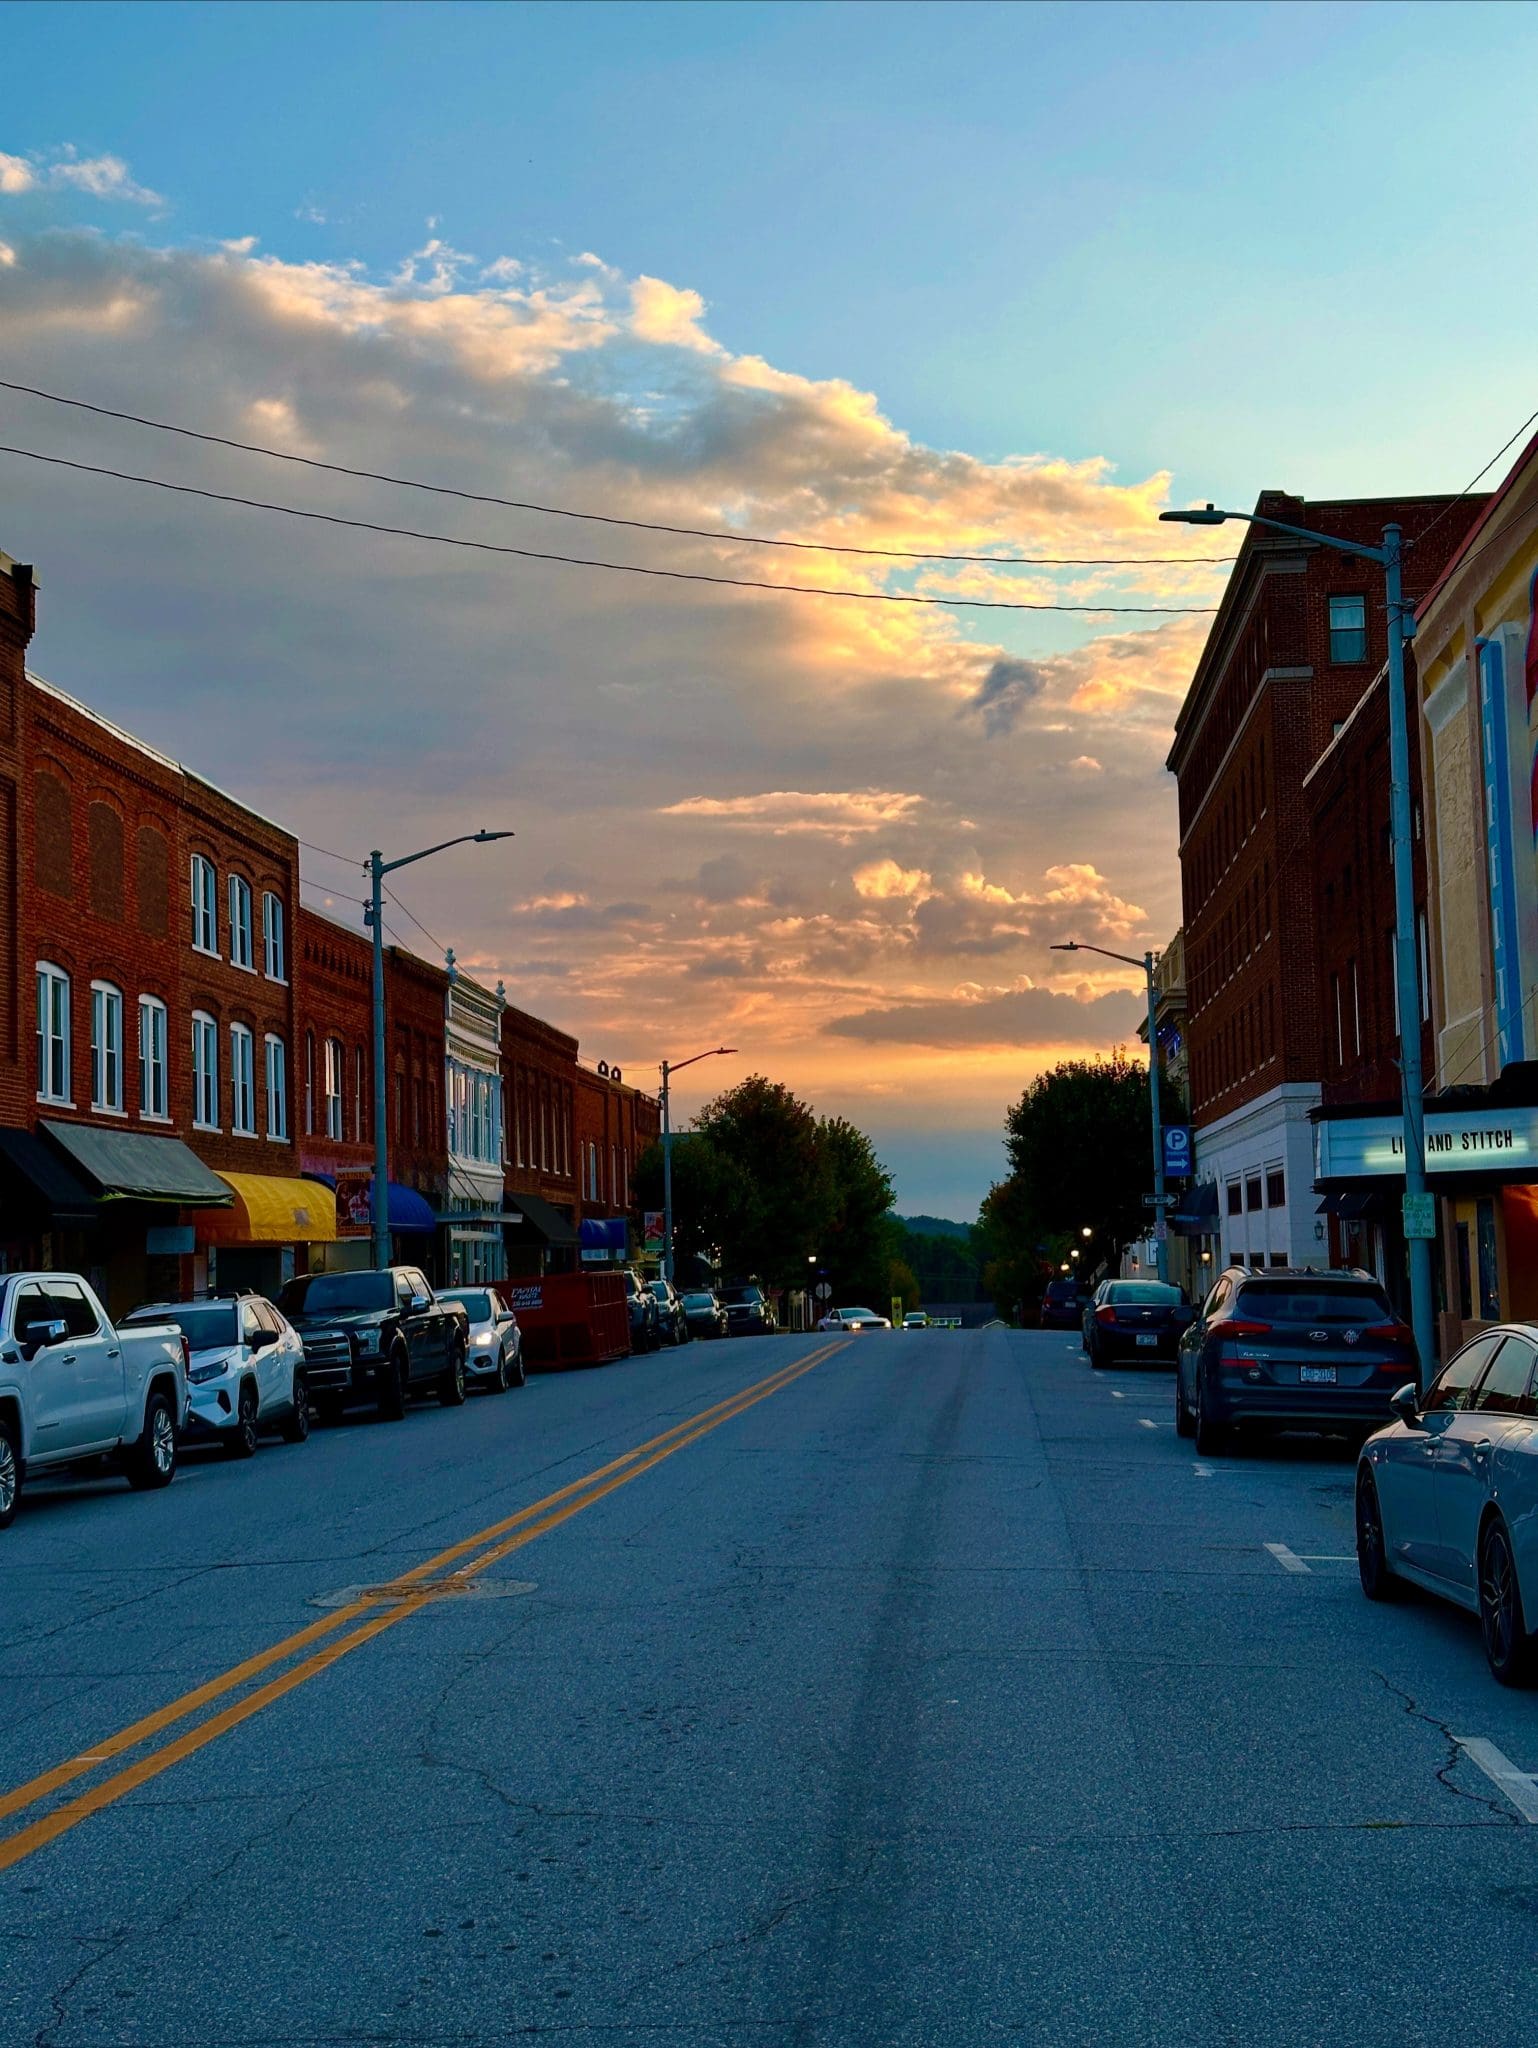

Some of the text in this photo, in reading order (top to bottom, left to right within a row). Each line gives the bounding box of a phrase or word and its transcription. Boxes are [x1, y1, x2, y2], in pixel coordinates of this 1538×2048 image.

[1171, 1132, 1184, 1148] P
[1428, 1133, 1452, 1152] AND
[1461, 1129, 1513, 1150] STITCH
[1405, 1196, 1413, 1208] 2
